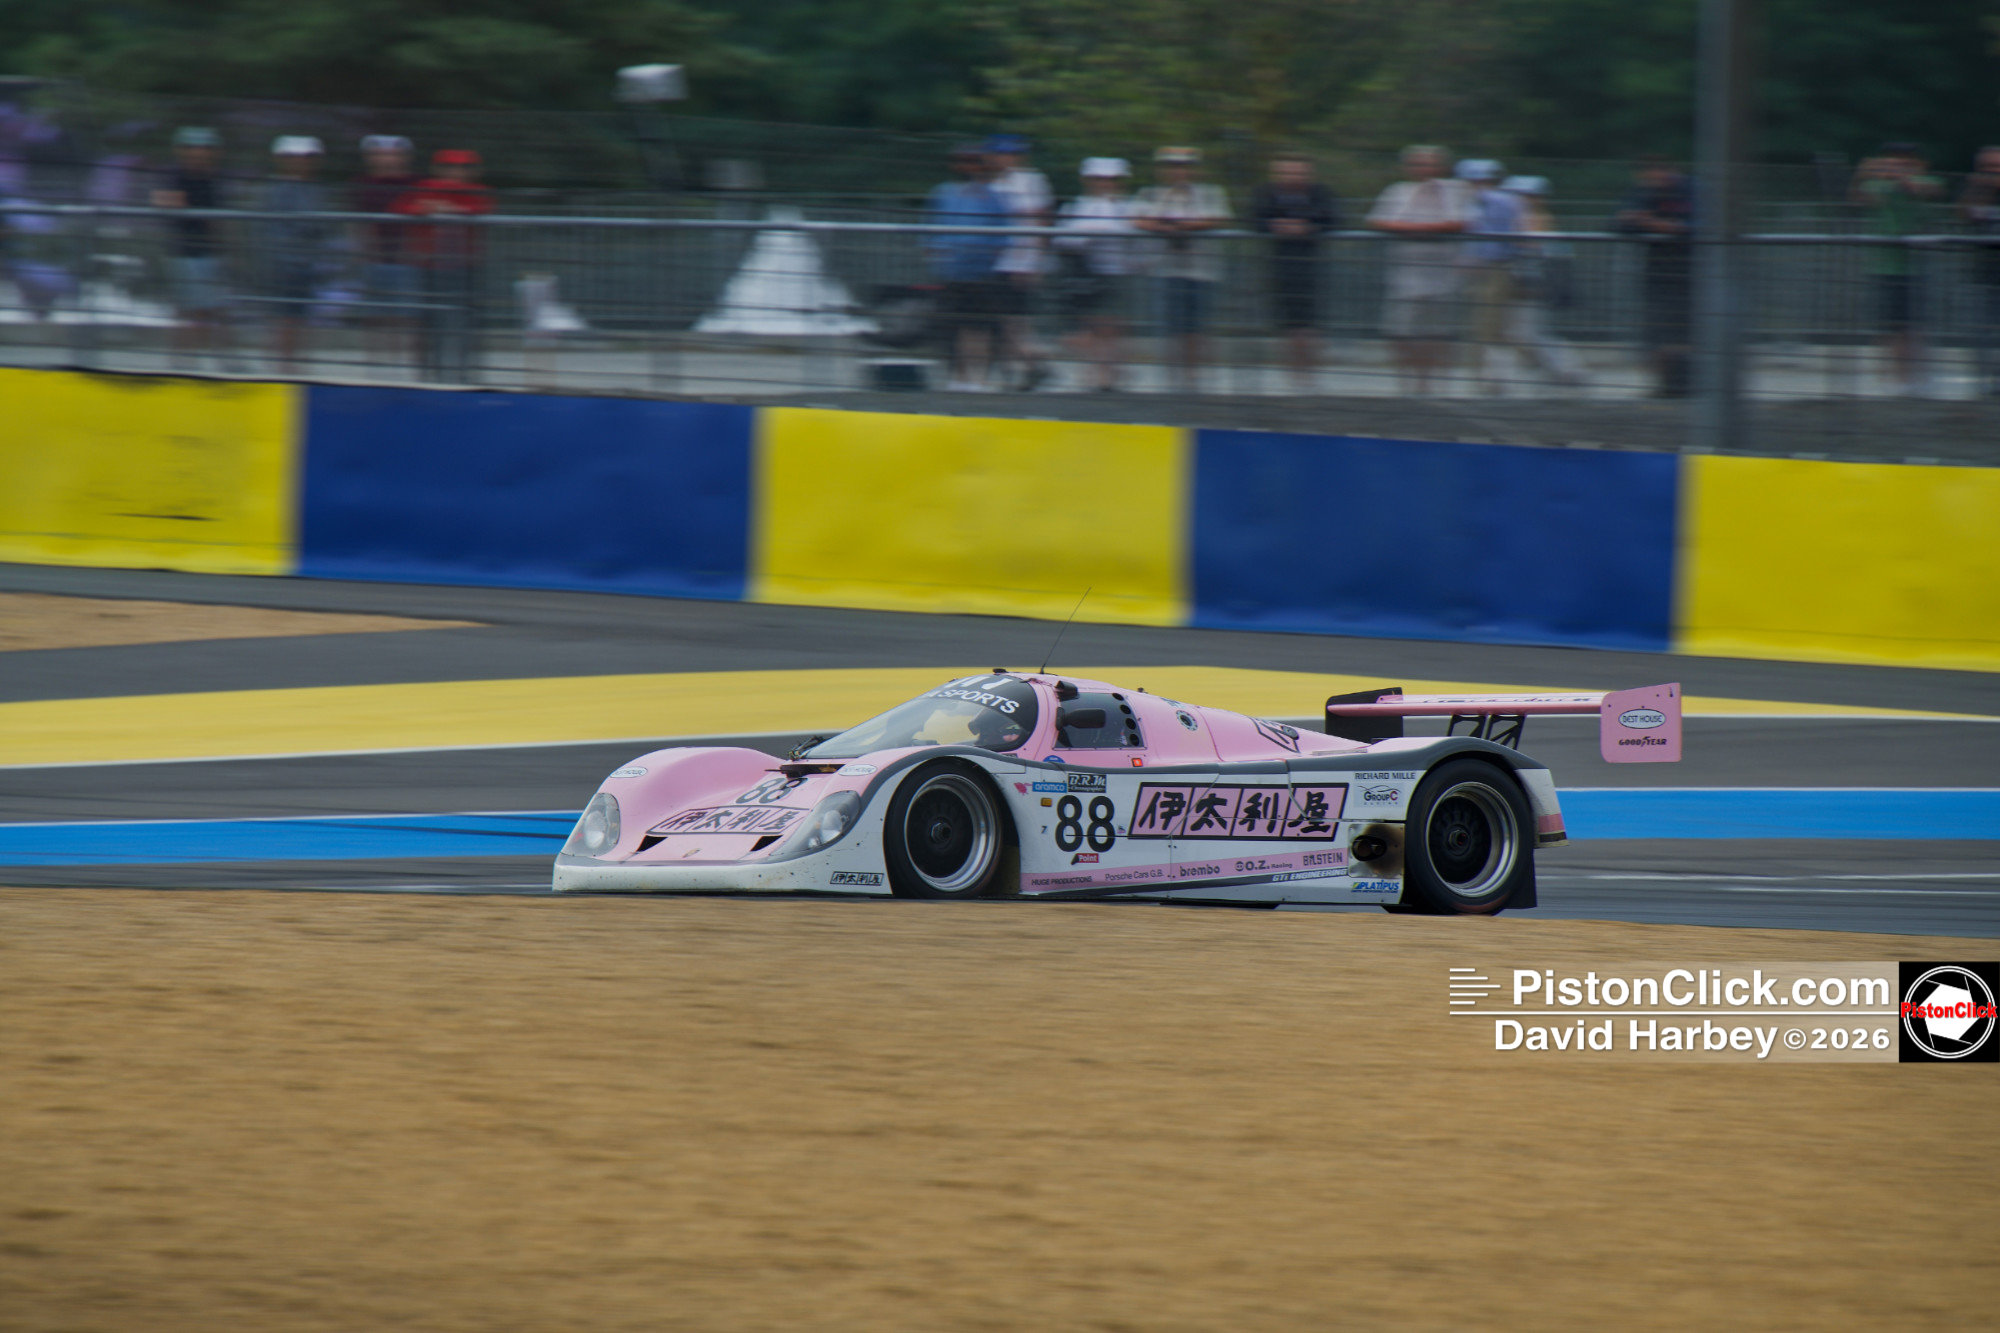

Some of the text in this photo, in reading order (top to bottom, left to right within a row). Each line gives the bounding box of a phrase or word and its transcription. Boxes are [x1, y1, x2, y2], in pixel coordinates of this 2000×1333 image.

[938, 689, 1020, 714] SPORTS
[1622, 715, 1662, 723] BEST HOUSE
[1355, 772, 1416, 780] RICHARD MILLE
[736, 777, 809, 804] 88
[1035, 783, 1065, 792] aramco
[1138, 791, 1331, 834] 伊太利屋
[1055, 795, 1116, 852] 88
[1303, 852, 1343, 867] BILSTEIN
[1105, 869, 1164, 882] Porsche Cars G.B.
[1180, 864, 1221, 877] brembo
[1290, 868, 1348, 881] ENGINEERING
[1031, 876, 1093, 886] HUGE PRODUCTIONS
